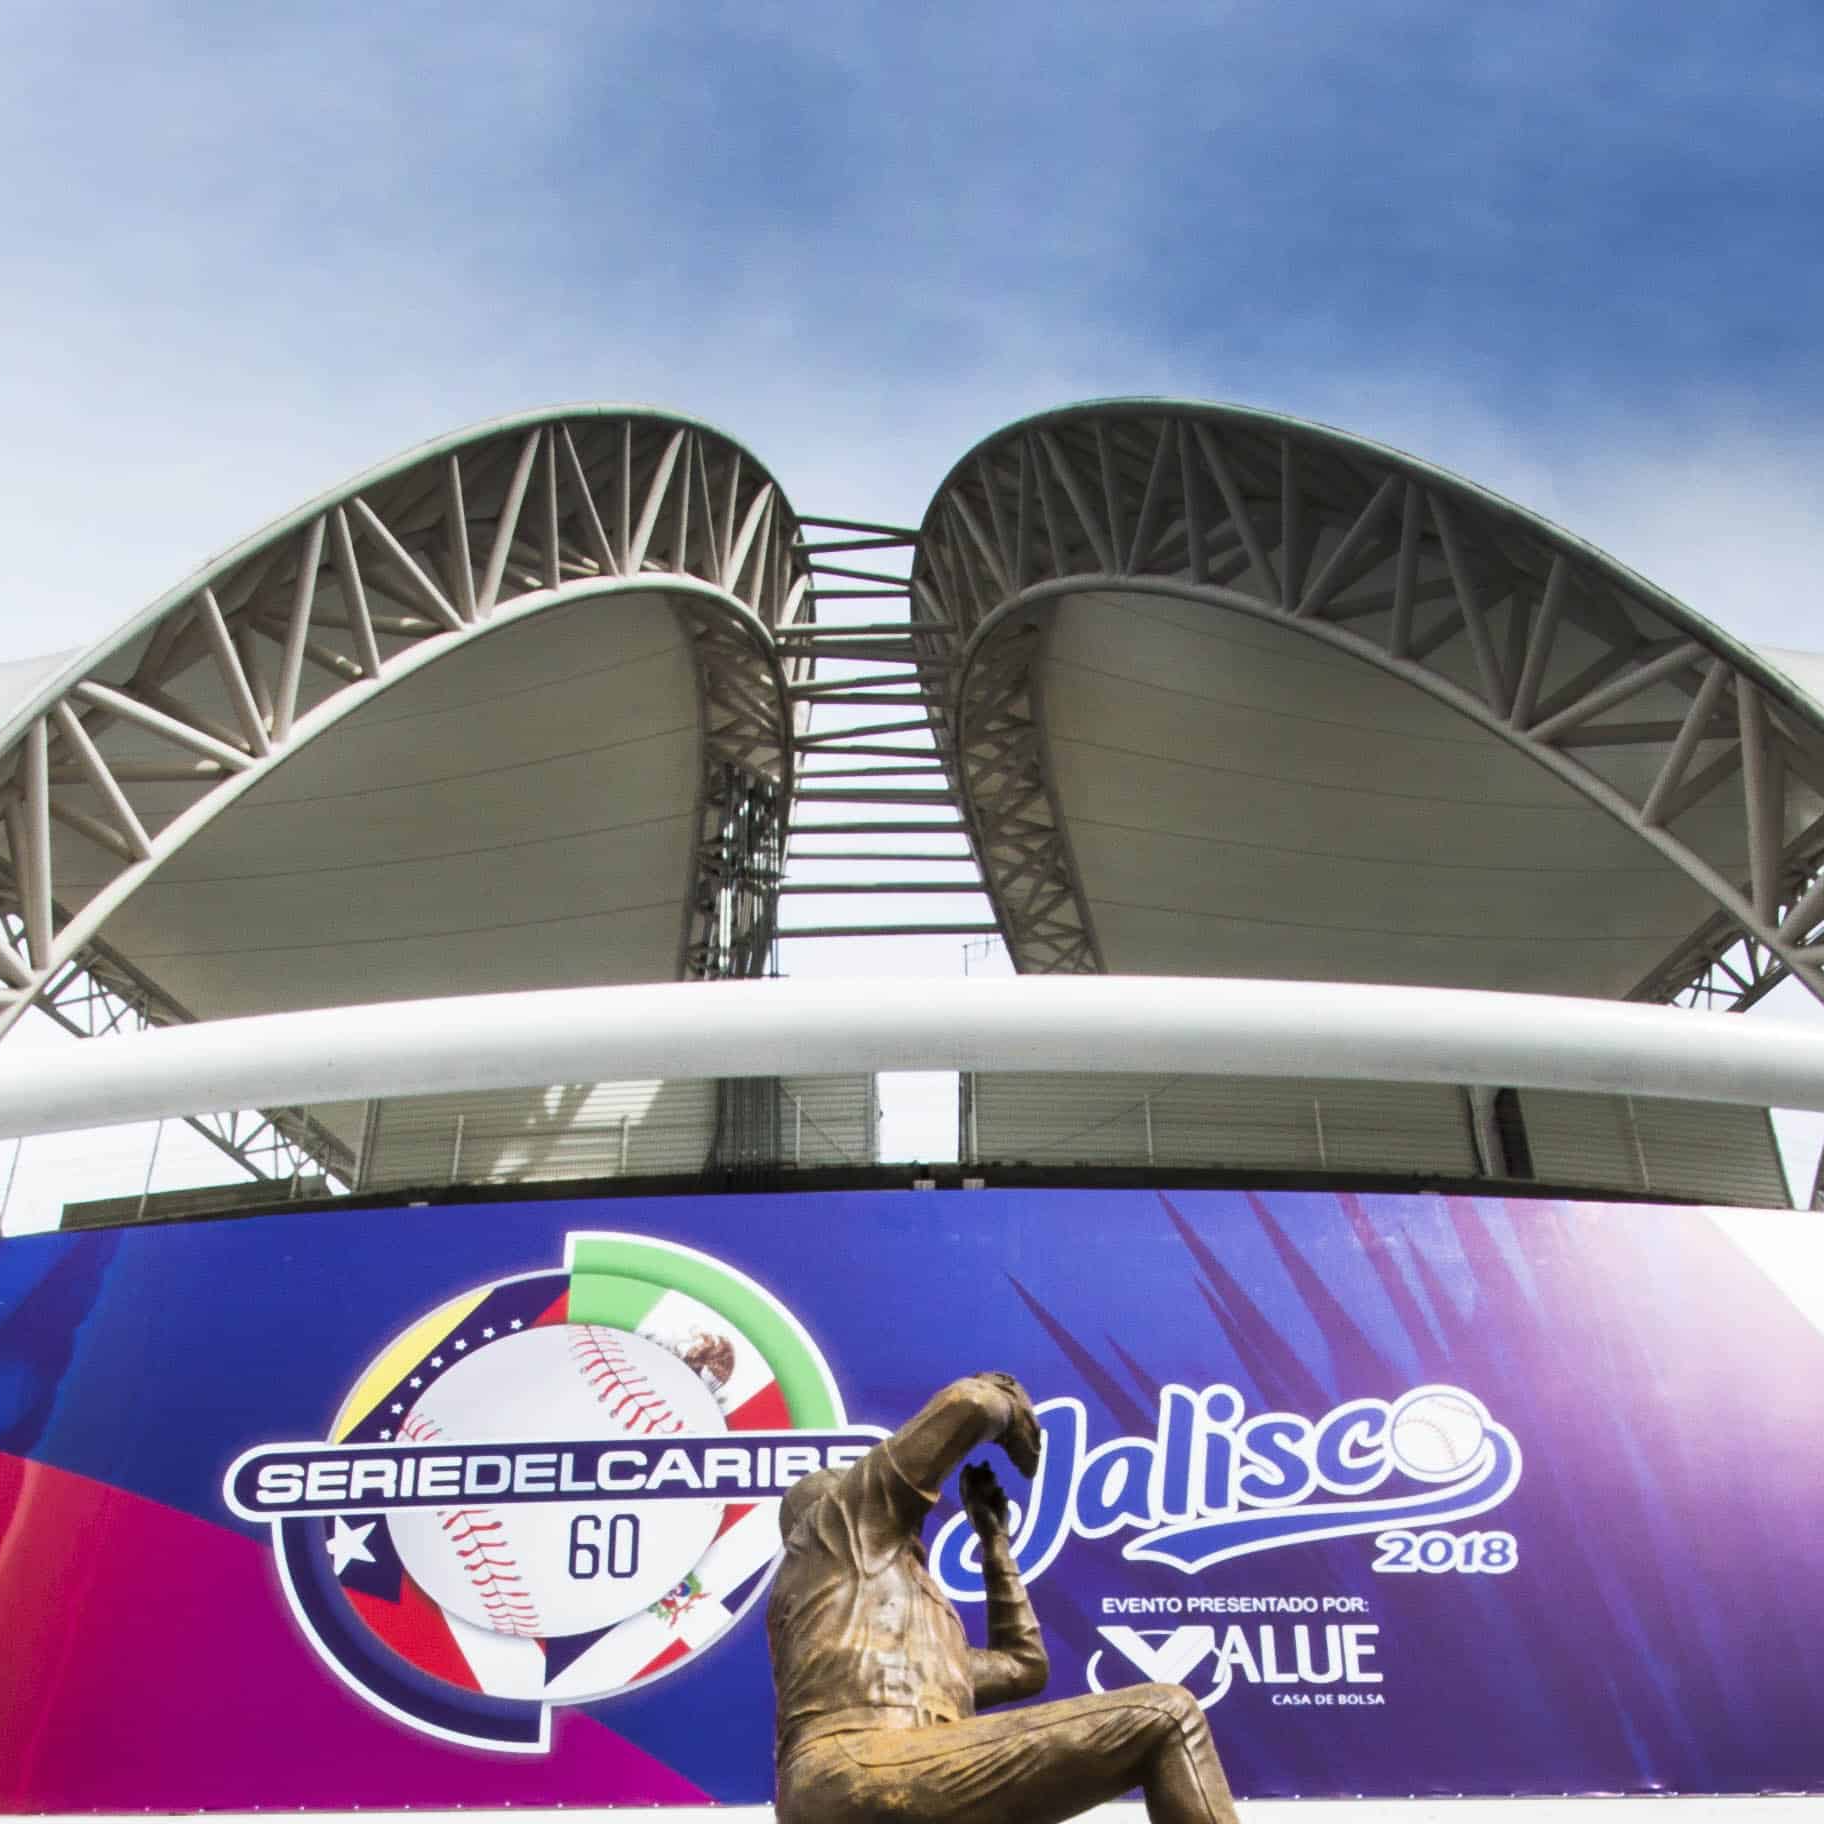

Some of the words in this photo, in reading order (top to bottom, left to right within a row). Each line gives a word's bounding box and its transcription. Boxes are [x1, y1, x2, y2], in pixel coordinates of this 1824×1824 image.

[567, 1512, 640, 1580] 60
[1372, 1530, 1518, 1574] 2018
[1102, 1597, 1181, 1614] EVENTO
[1186, 1596, 1318, 1614] PRESENTADO
[1322, 1596, 1370, 1613] POR:
[1272, 1693, 1311, 1705] CASA
[1315, 1693, 1335, 1705] DE
[1338, 1693, 1385, 1705] BOLSA
